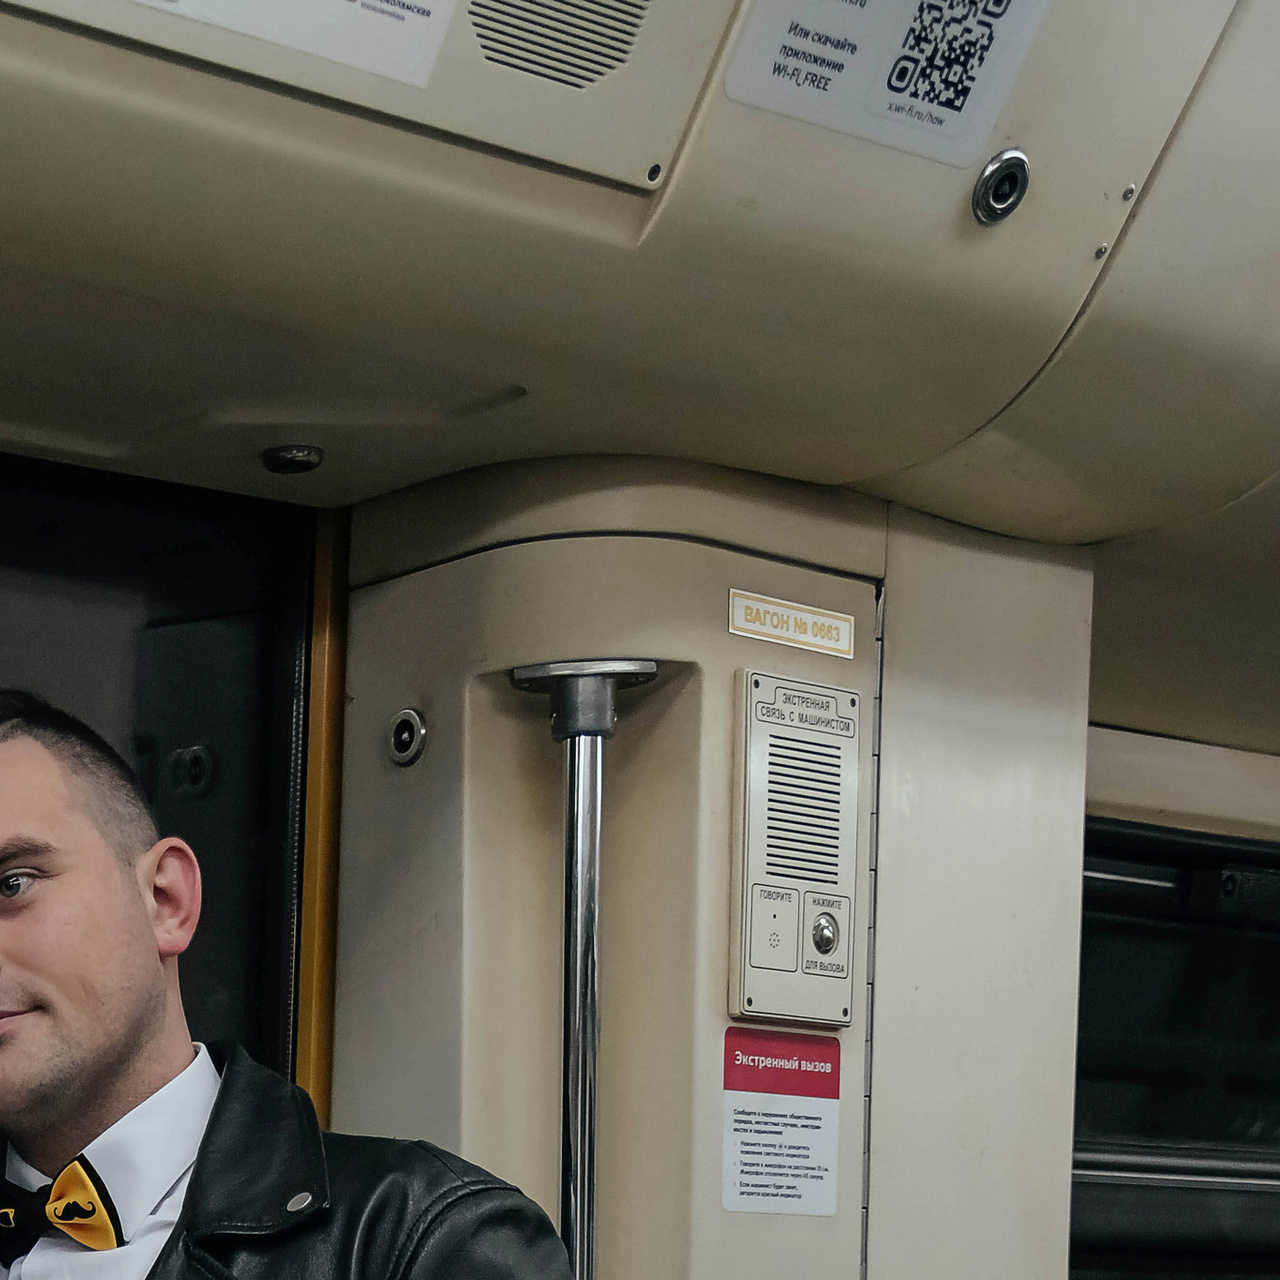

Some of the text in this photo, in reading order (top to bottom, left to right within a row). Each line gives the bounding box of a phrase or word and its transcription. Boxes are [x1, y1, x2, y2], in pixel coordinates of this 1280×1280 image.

[788, 21, 858, 55] Или скачайте
[779, 44, 845, 73] приложение
[744, 605, 790, 632] ВАГОН
[793, 616, 808, 635] №
[782, 693, 830, 712] ЭКСТРЕННАЯ
[761, 705, 850, 732] СВЯЗЬ С МАШИНИСТОМ
[760, 889, 792, 903] ГОВОРИТЕ
[812, 897, 842, 910] НАЖМИТЕ
[805, 960, 845, 973] ДЛЯ ВЫЗОВА
[734, 1050, 832, 1073] Экстренный вызов
